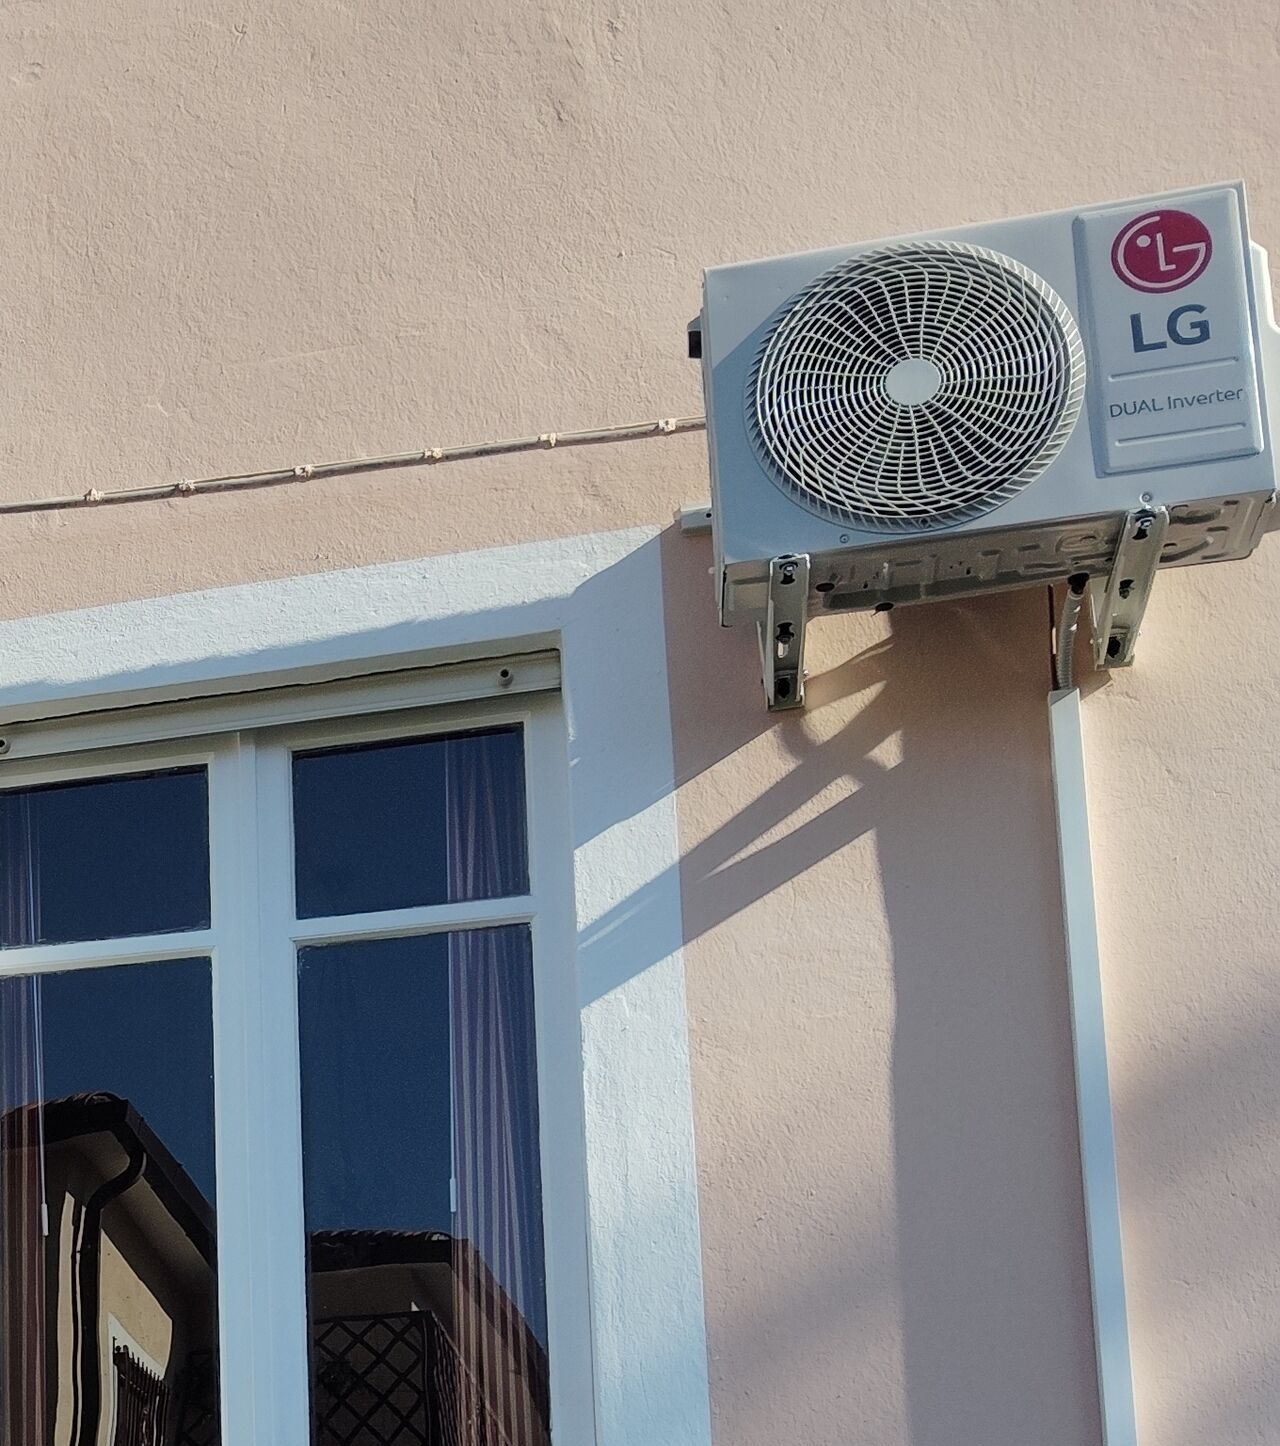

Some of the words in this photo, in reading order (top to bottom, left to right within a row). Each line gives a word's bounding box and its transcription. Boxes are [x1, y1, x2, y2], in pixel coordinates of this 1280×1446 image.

[1130, 304, 1211, 353] LG
[1109, 398, 1164, 418] DUAL
[1167, 388, 1244, 410] Inverter
